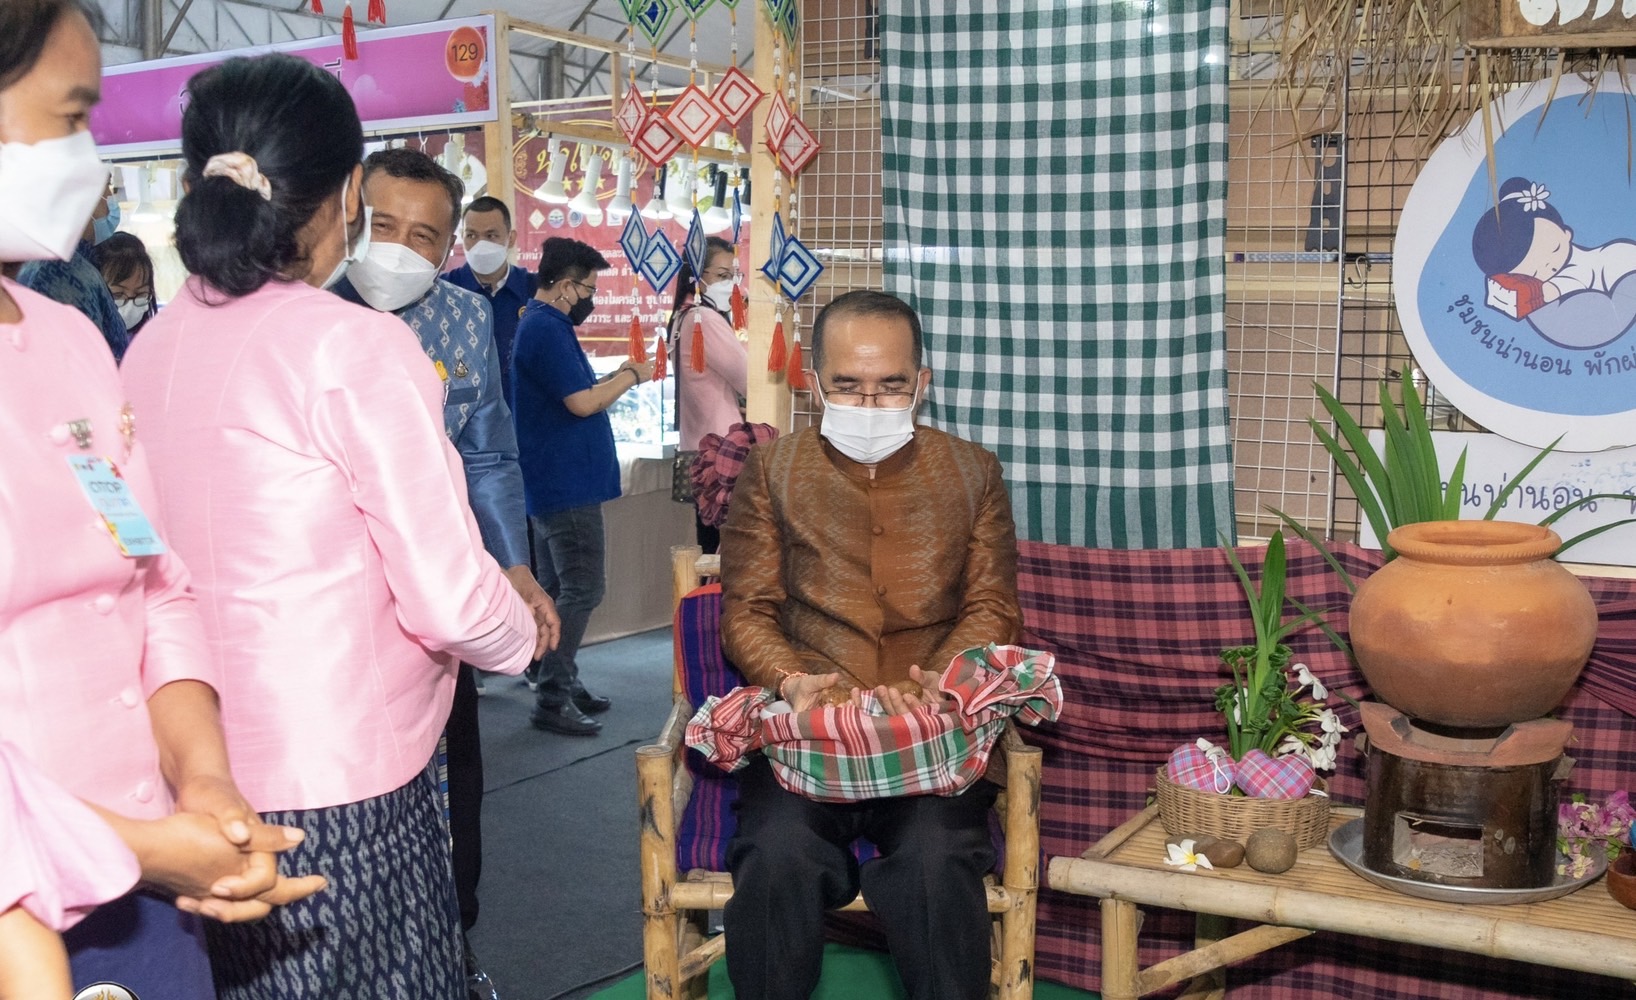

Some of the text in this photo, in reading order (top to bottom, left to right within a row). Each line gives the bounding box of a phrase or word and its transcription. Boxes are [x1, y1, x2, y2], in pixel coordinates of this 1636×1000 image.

[451, 43, 478, 62] 129
[1446, 294, 1573, 376] ชุมชนน่านอน
